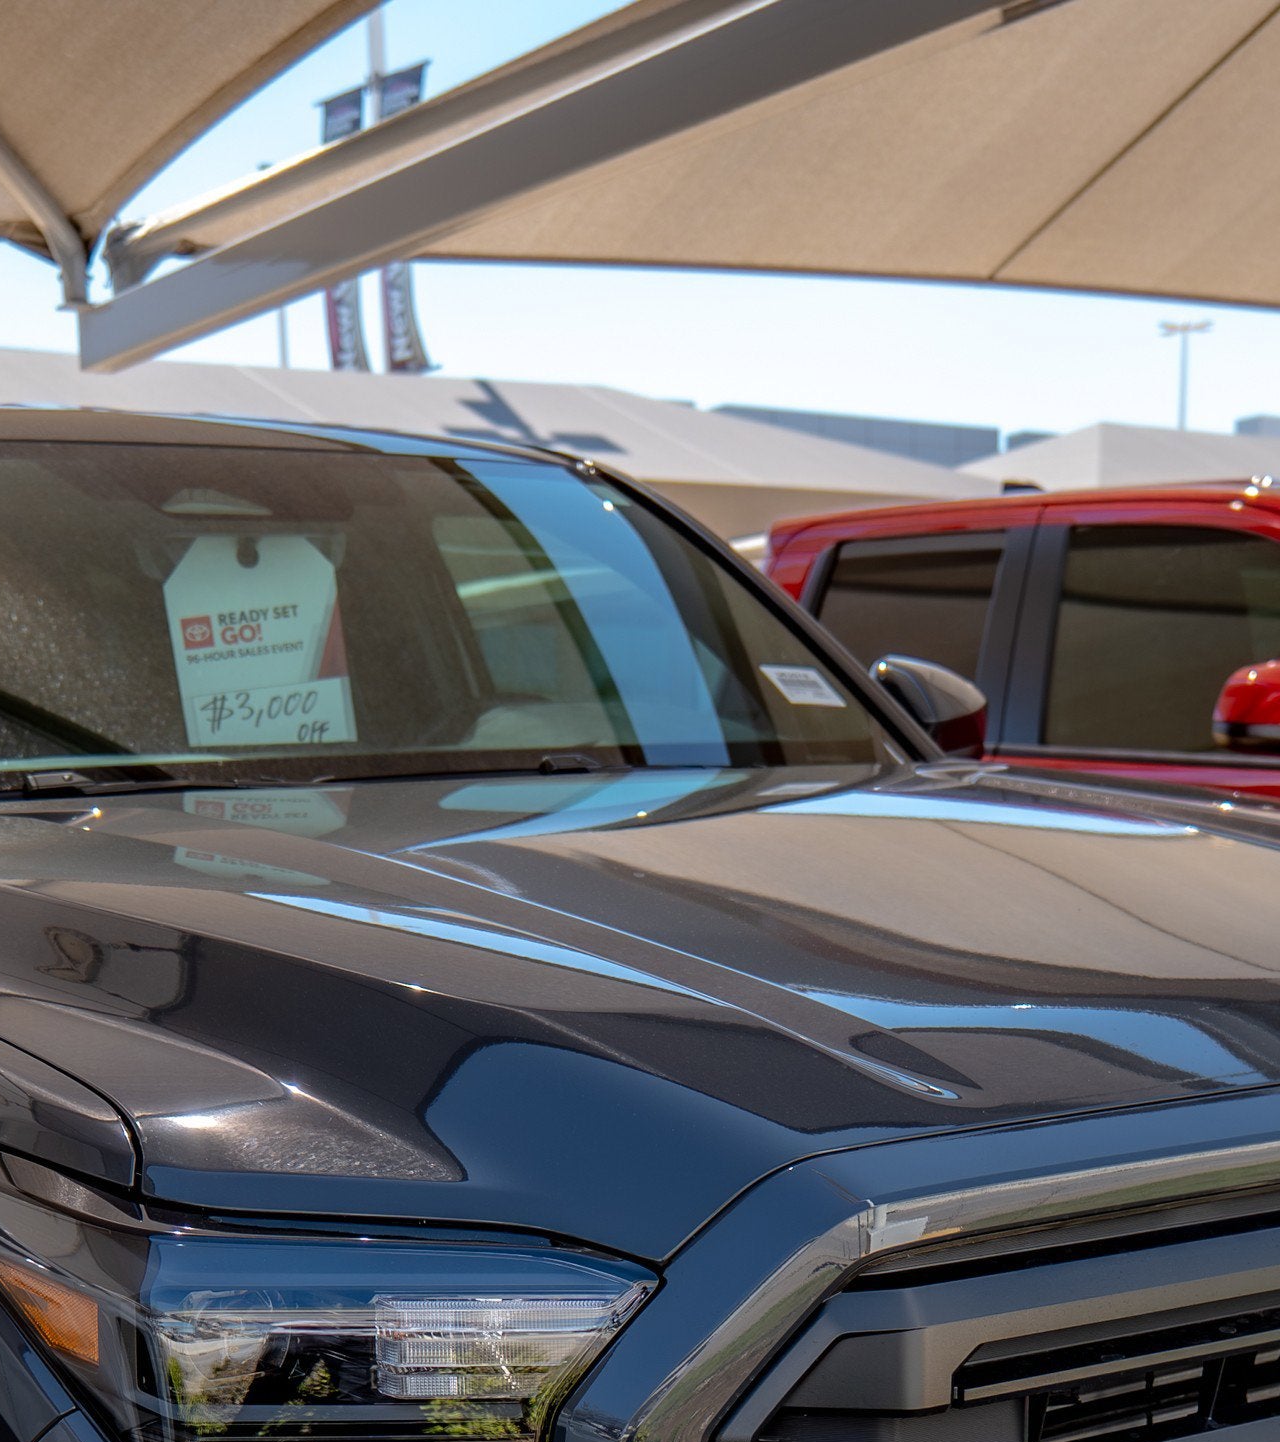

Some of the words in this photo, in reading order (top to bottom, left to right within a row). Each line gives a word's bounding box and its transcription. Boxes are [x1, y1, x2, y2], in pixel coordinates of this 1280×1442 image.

[217, 608, 269, 626] READY
[273, 604, 299, 620] SET
[220, 623, 264, 645] GO!
[238, 646, 270, 659] SALES
[271, 641, 305, 655] EVENT
[200, 690, 318, 734] $3,000
